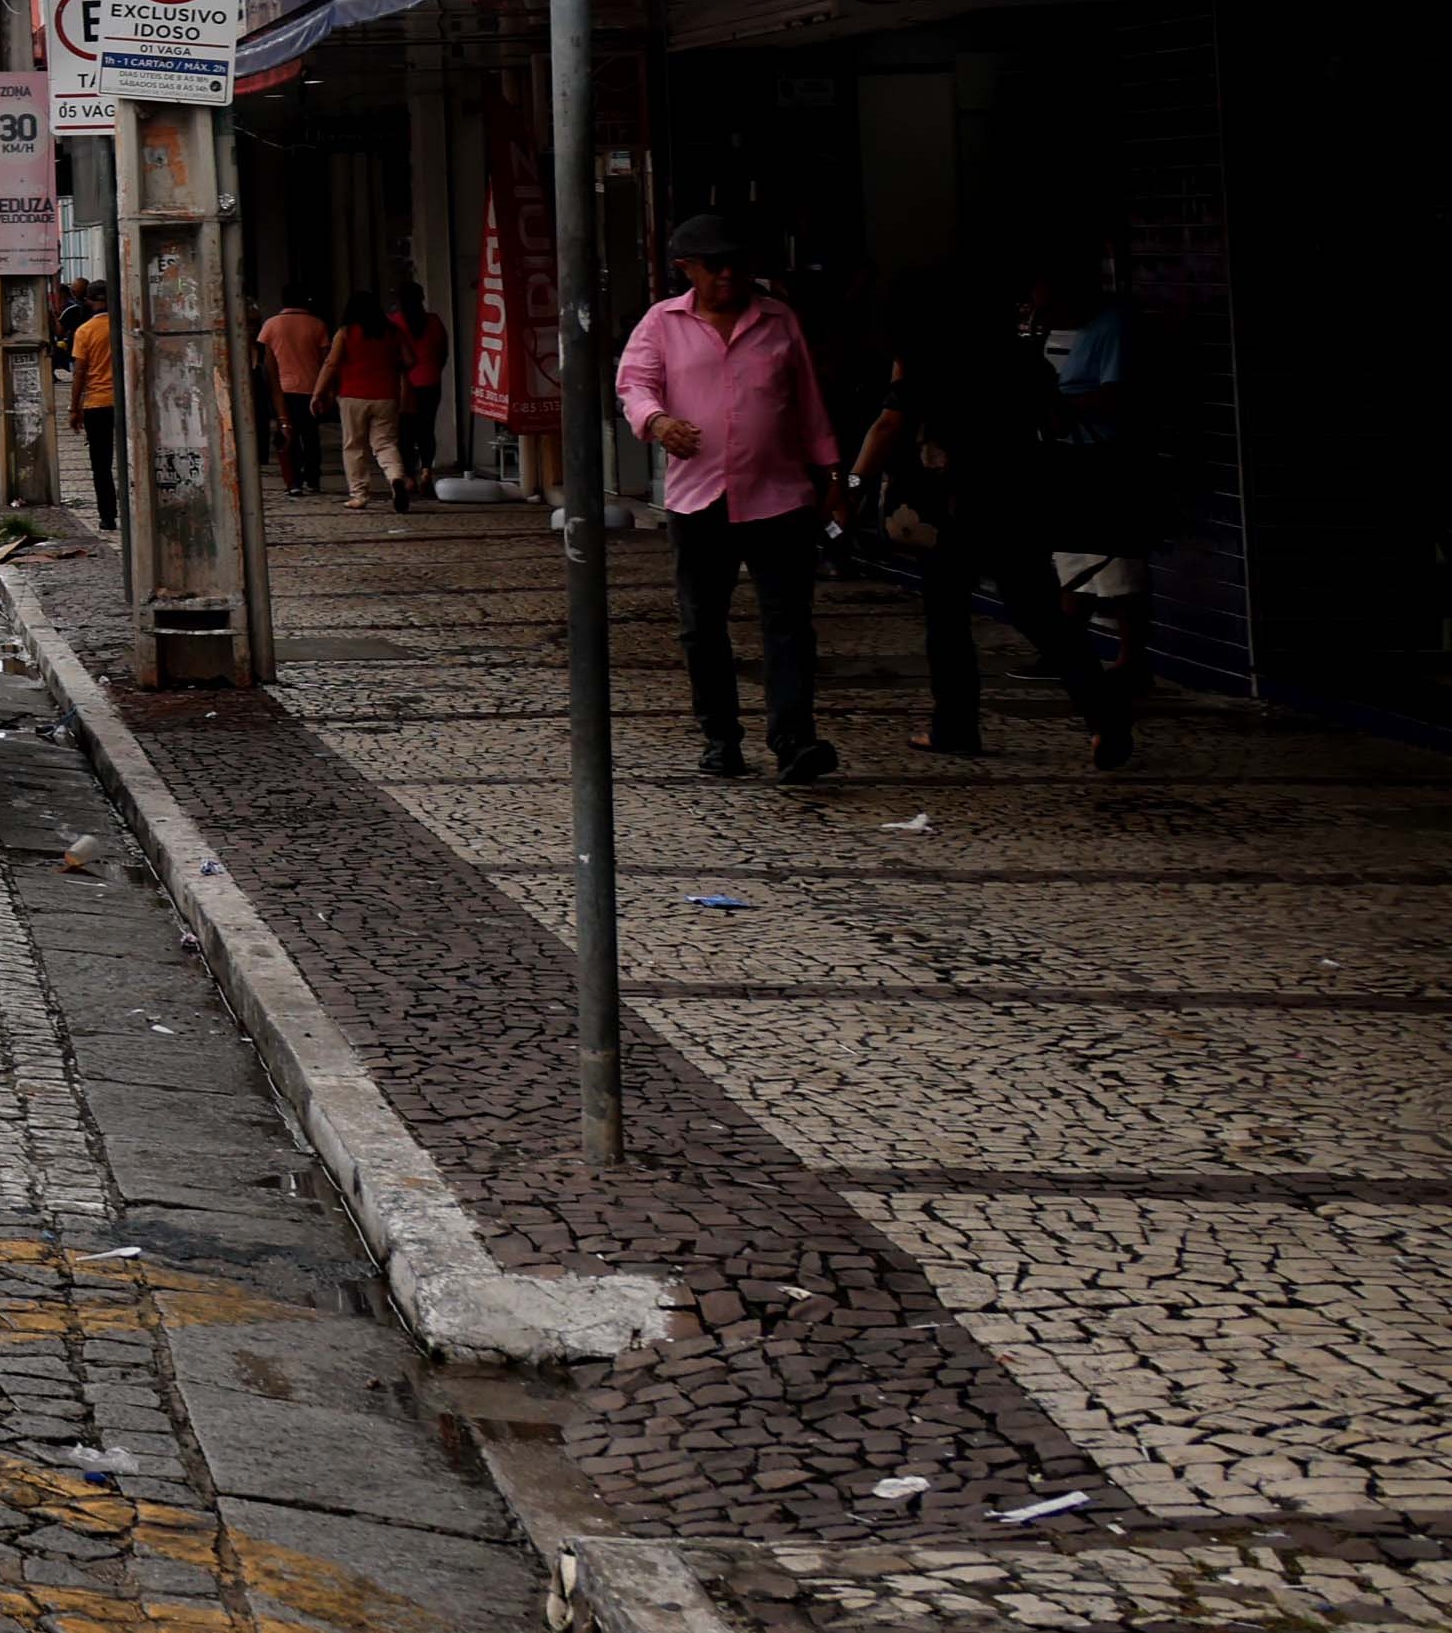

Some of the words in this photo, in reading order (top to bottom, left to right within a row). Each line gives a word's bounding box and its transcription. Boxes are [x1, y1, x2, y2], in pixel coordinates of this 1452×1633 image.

[111, 4, 227, 25] EXCLUSIVO
[134, 23, 201, 40] IDOSO
[140, 44, 153, 53] 01
[157, 46, 192, 56] VAGA
[212, 64, 226, 73] 2h
[0, 86, 32, 98] ZONA
[159, 82, 174, 90] DAS
[58, 104, 77, 118] 05
[2, 143, 35, 154] KM/H
